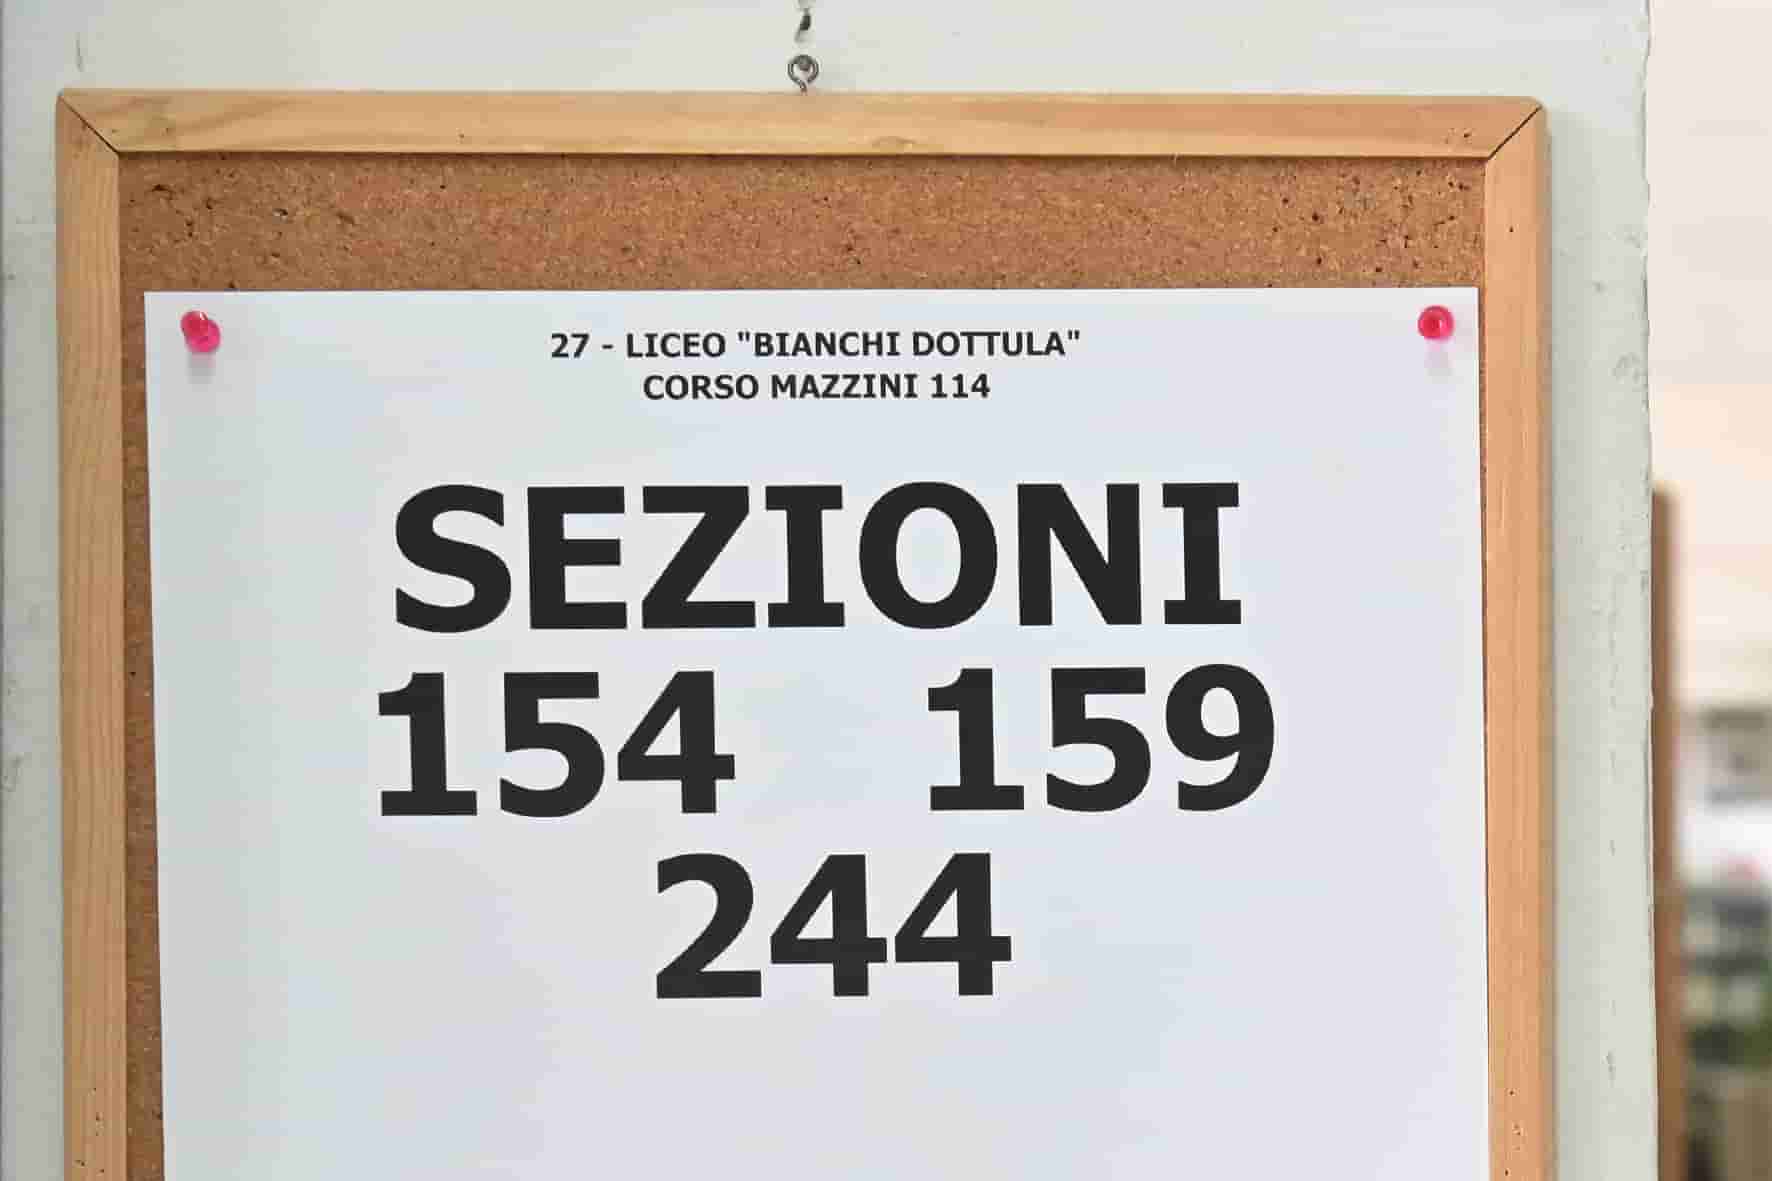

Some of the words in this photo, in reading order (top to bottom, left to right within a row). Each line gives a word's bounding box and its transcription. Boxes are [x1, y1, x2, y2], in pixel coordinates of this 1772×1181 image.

[551, 333, 590, 358] 27
[626, 332, 726, 358] LICEO
[738, 331, 900, 357] "BIANCHI
[912, 330, 1080, 357] DOTTULA"
[643, 374, 759, 401] CORSO
[771, 373, 918, 399] MAZZINI
[931, 373, 991, 399] 114
[394, 480, 1243, 634] SEZIONI
[377, 669, 737, 818] 154
[926, 662, 1276, 814] 159
[655, 851, 1013, 1000] 244
